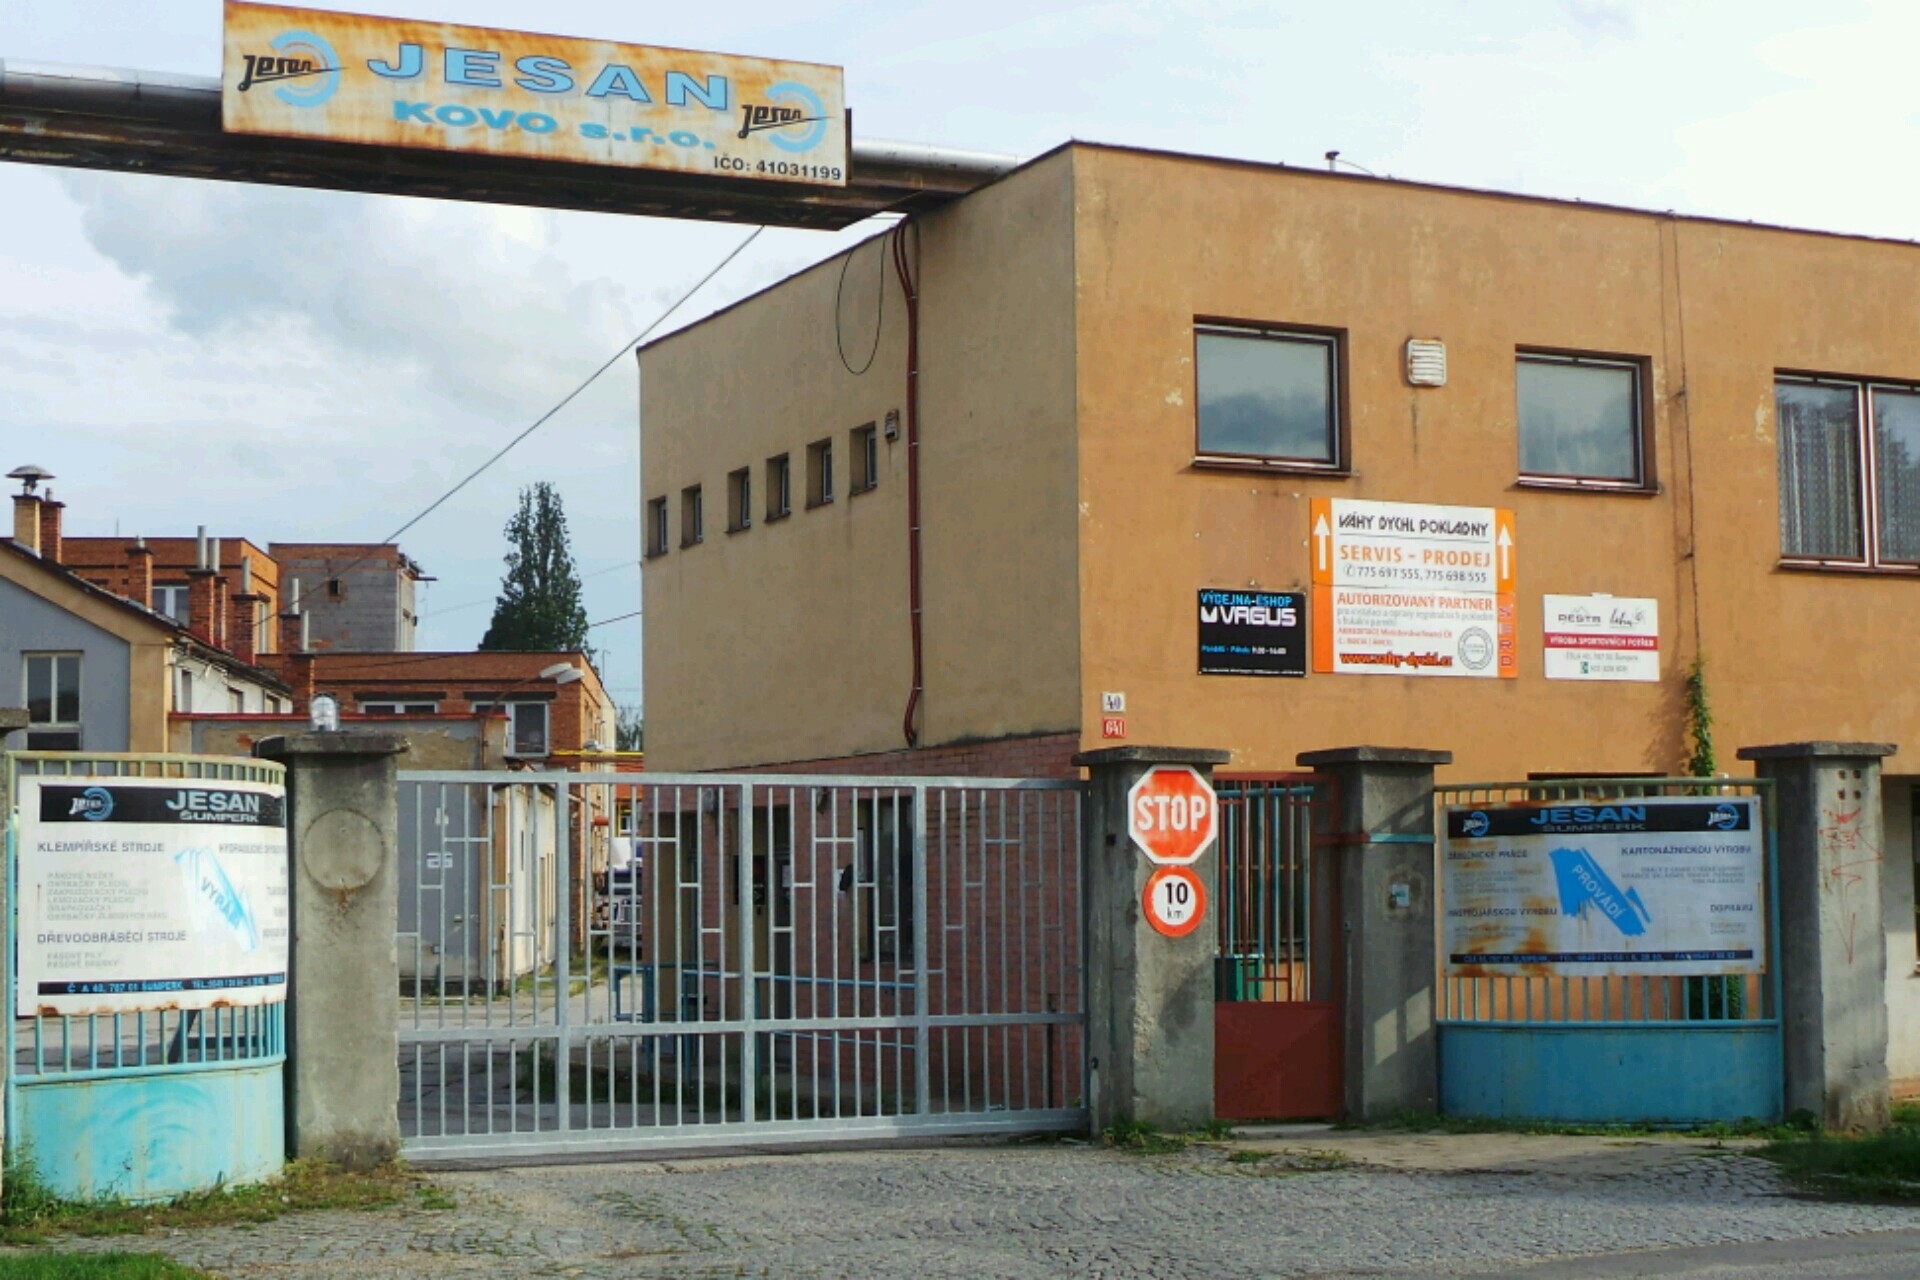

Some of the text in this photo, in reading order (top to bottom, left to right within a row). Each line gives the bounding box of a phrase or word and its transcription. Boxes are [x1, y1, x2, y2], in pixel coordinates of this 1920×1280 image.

[367, 42, 728, 111] JESAN
[393, 99, 717, 150] KOVO s.r.o.
[714, 153, 842, 181] IČO: 41031199
[1339, 511, 1375, 530] VÁHY
[1419, 519, 1489, 538] POKLADNY
[1340, 544, 1403, 563] SERVIS
[1423, 549, 1491, 567] PRODEJ
[1357, 566, 1376, 578] 775
[1425, 569, 1444, 581] 775
[1468, 571, 1487, 583] 555
[1439, 597, 1494, 611] PARTNER
[1106, 695, 1121, 710] 40
[1106, 720, 1123, 735] 641
[165, 789, 260, 813] JESAN
[1136, 794, 1207, 832] STOP
[1530, 805, 1647, 825] JESAN
[121, 842, 165, 852] STROJE
[1165, 882, 1189, 905] 10
[1166, 905, 1185, 919] km
[147, 931, 187, 942] STROJE
